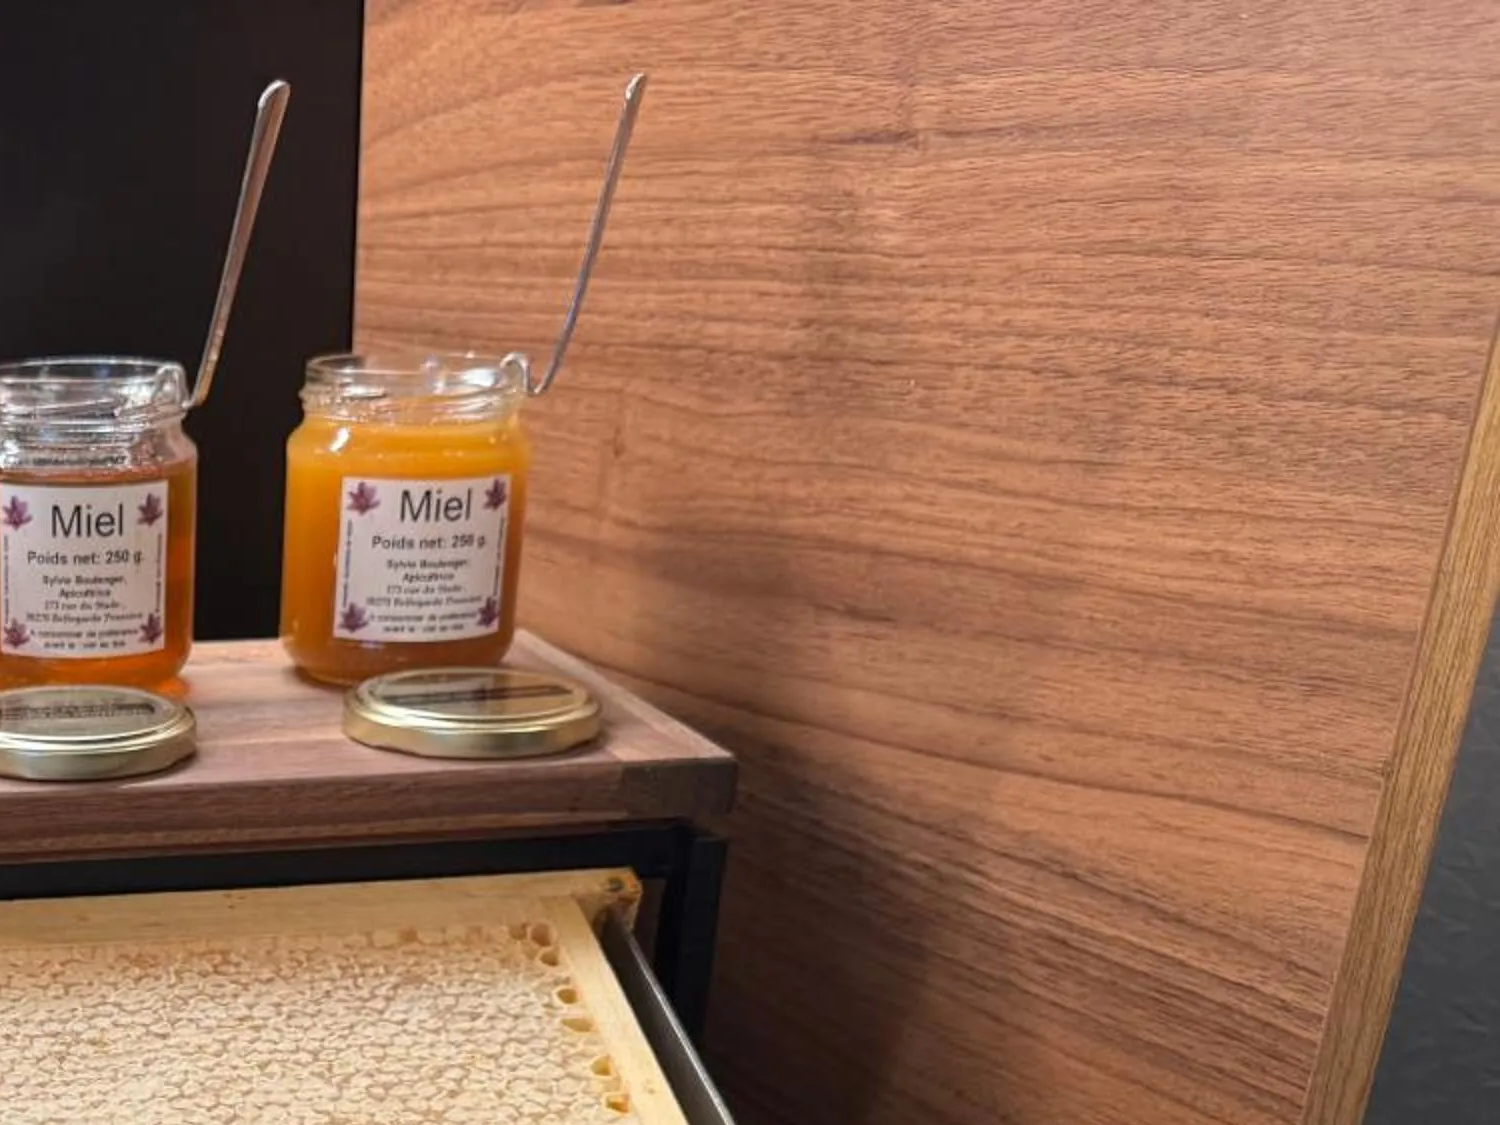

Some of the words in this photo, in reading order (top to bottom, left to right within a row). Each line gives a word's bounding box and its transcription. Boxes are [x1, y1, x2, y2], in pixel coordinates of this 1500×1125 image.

[399, 488, 472, 523] Miel
[51, 503, 124, 538] Miel
[371, 536, 414, 549] Poids
[420, 536, 446, 549] net:
[27, 551, 67, 565] Poids
[73, 551, 101, 565] net:
[105, 550, 130, 564] 250
